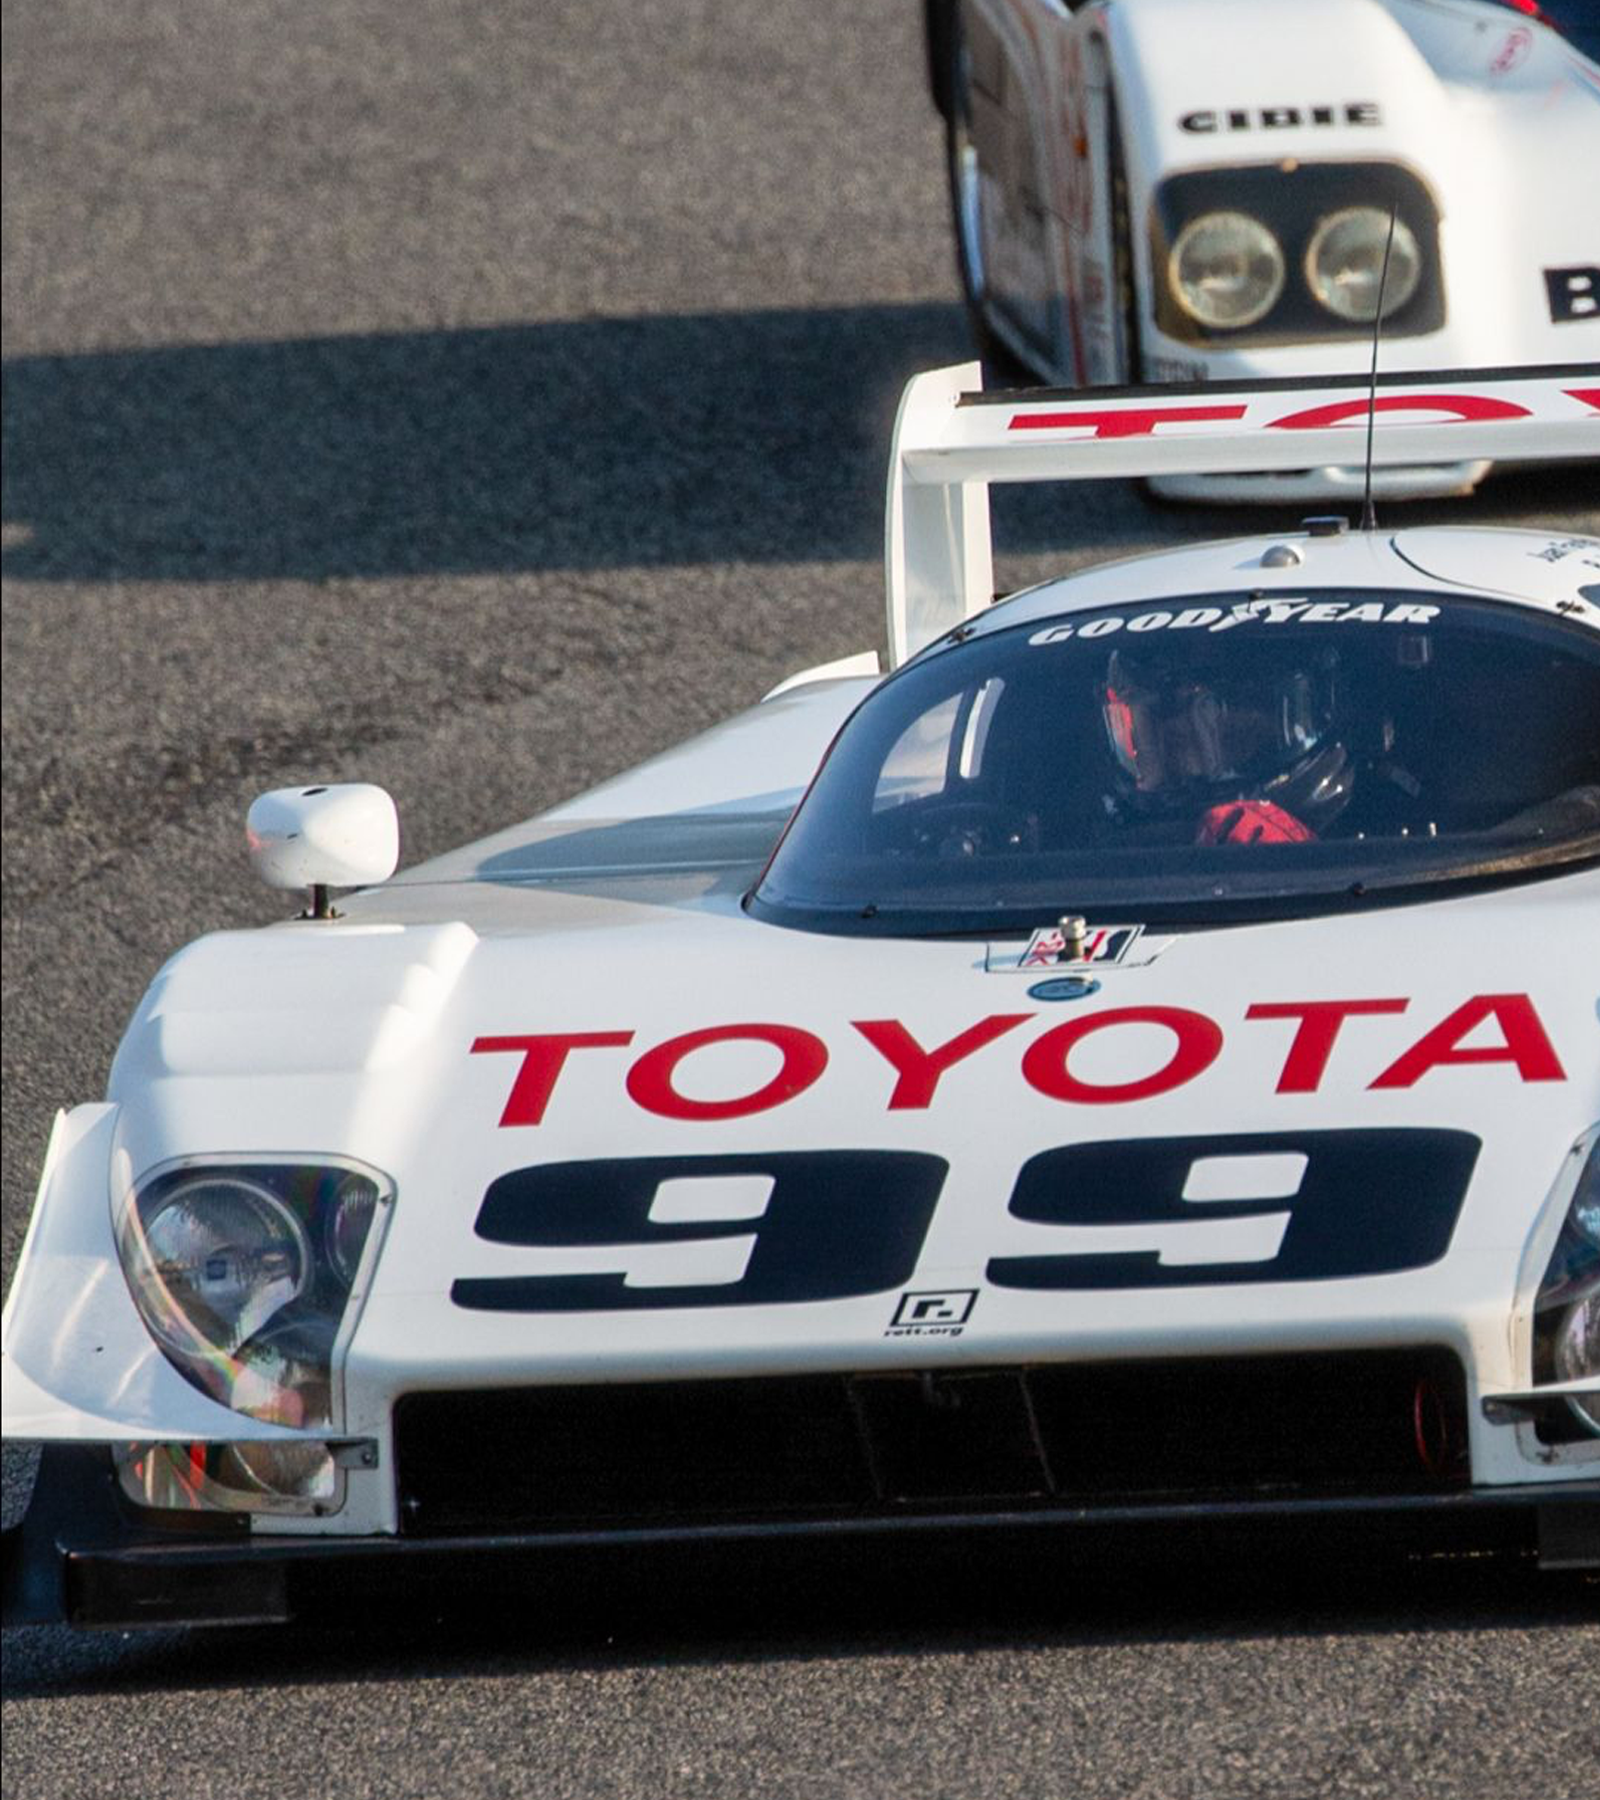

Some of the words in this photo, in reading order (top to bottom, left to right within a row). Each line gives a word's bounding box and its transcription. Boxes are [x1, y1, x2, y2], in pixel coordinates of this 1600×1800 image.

[1028, 597, 1442, 647] GOODYEAR
[470, 992, 1569, 1129] TOYOTA
[449, 1127, 1483, 1314] 99
